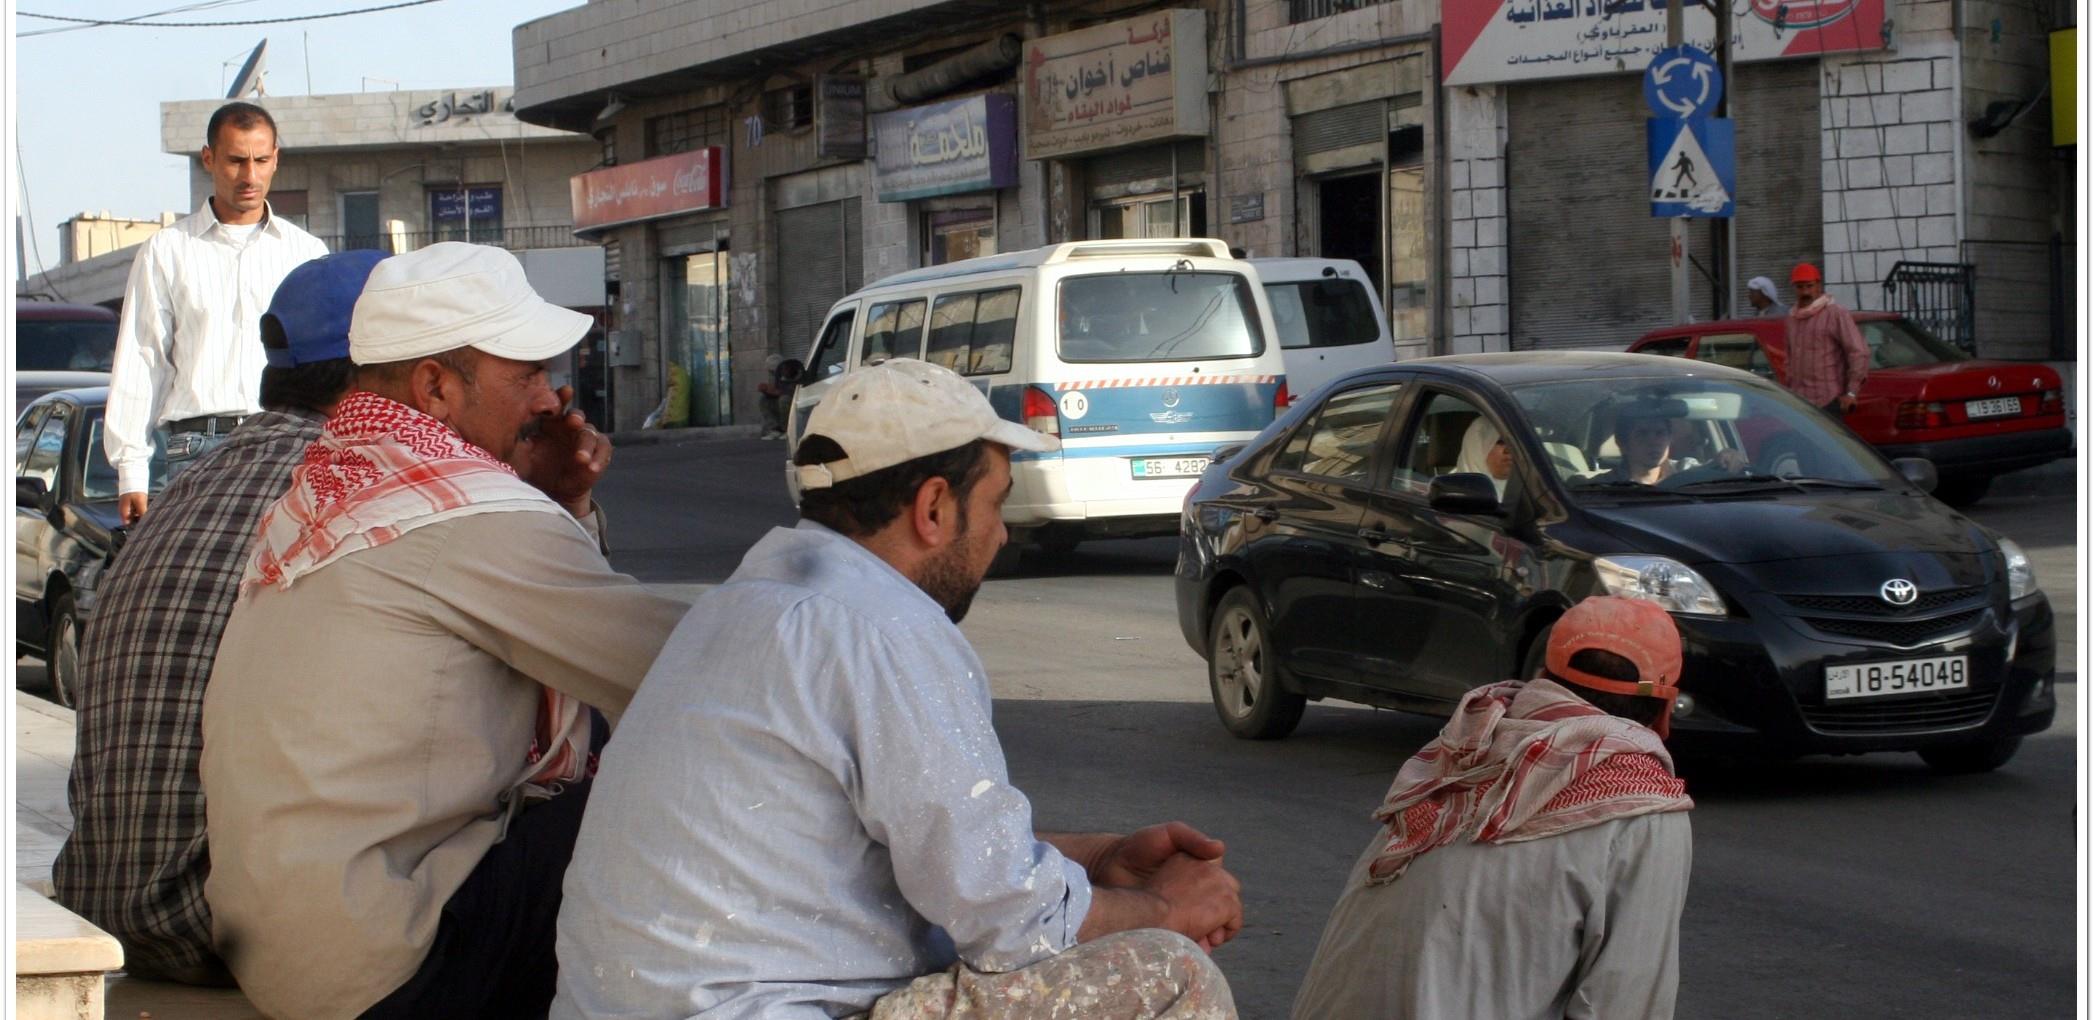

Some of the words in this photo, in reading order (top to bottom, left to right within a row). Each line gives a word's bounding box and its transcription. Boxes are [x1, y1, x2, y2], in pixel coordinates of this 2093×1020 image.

[419, 91, 495, 126] التجاري
[908, 105, 987, 166] ملحمة
[673, 164, 706, 196] Coca-Cola
[1856, 659, 1964, 693] 18-54048
